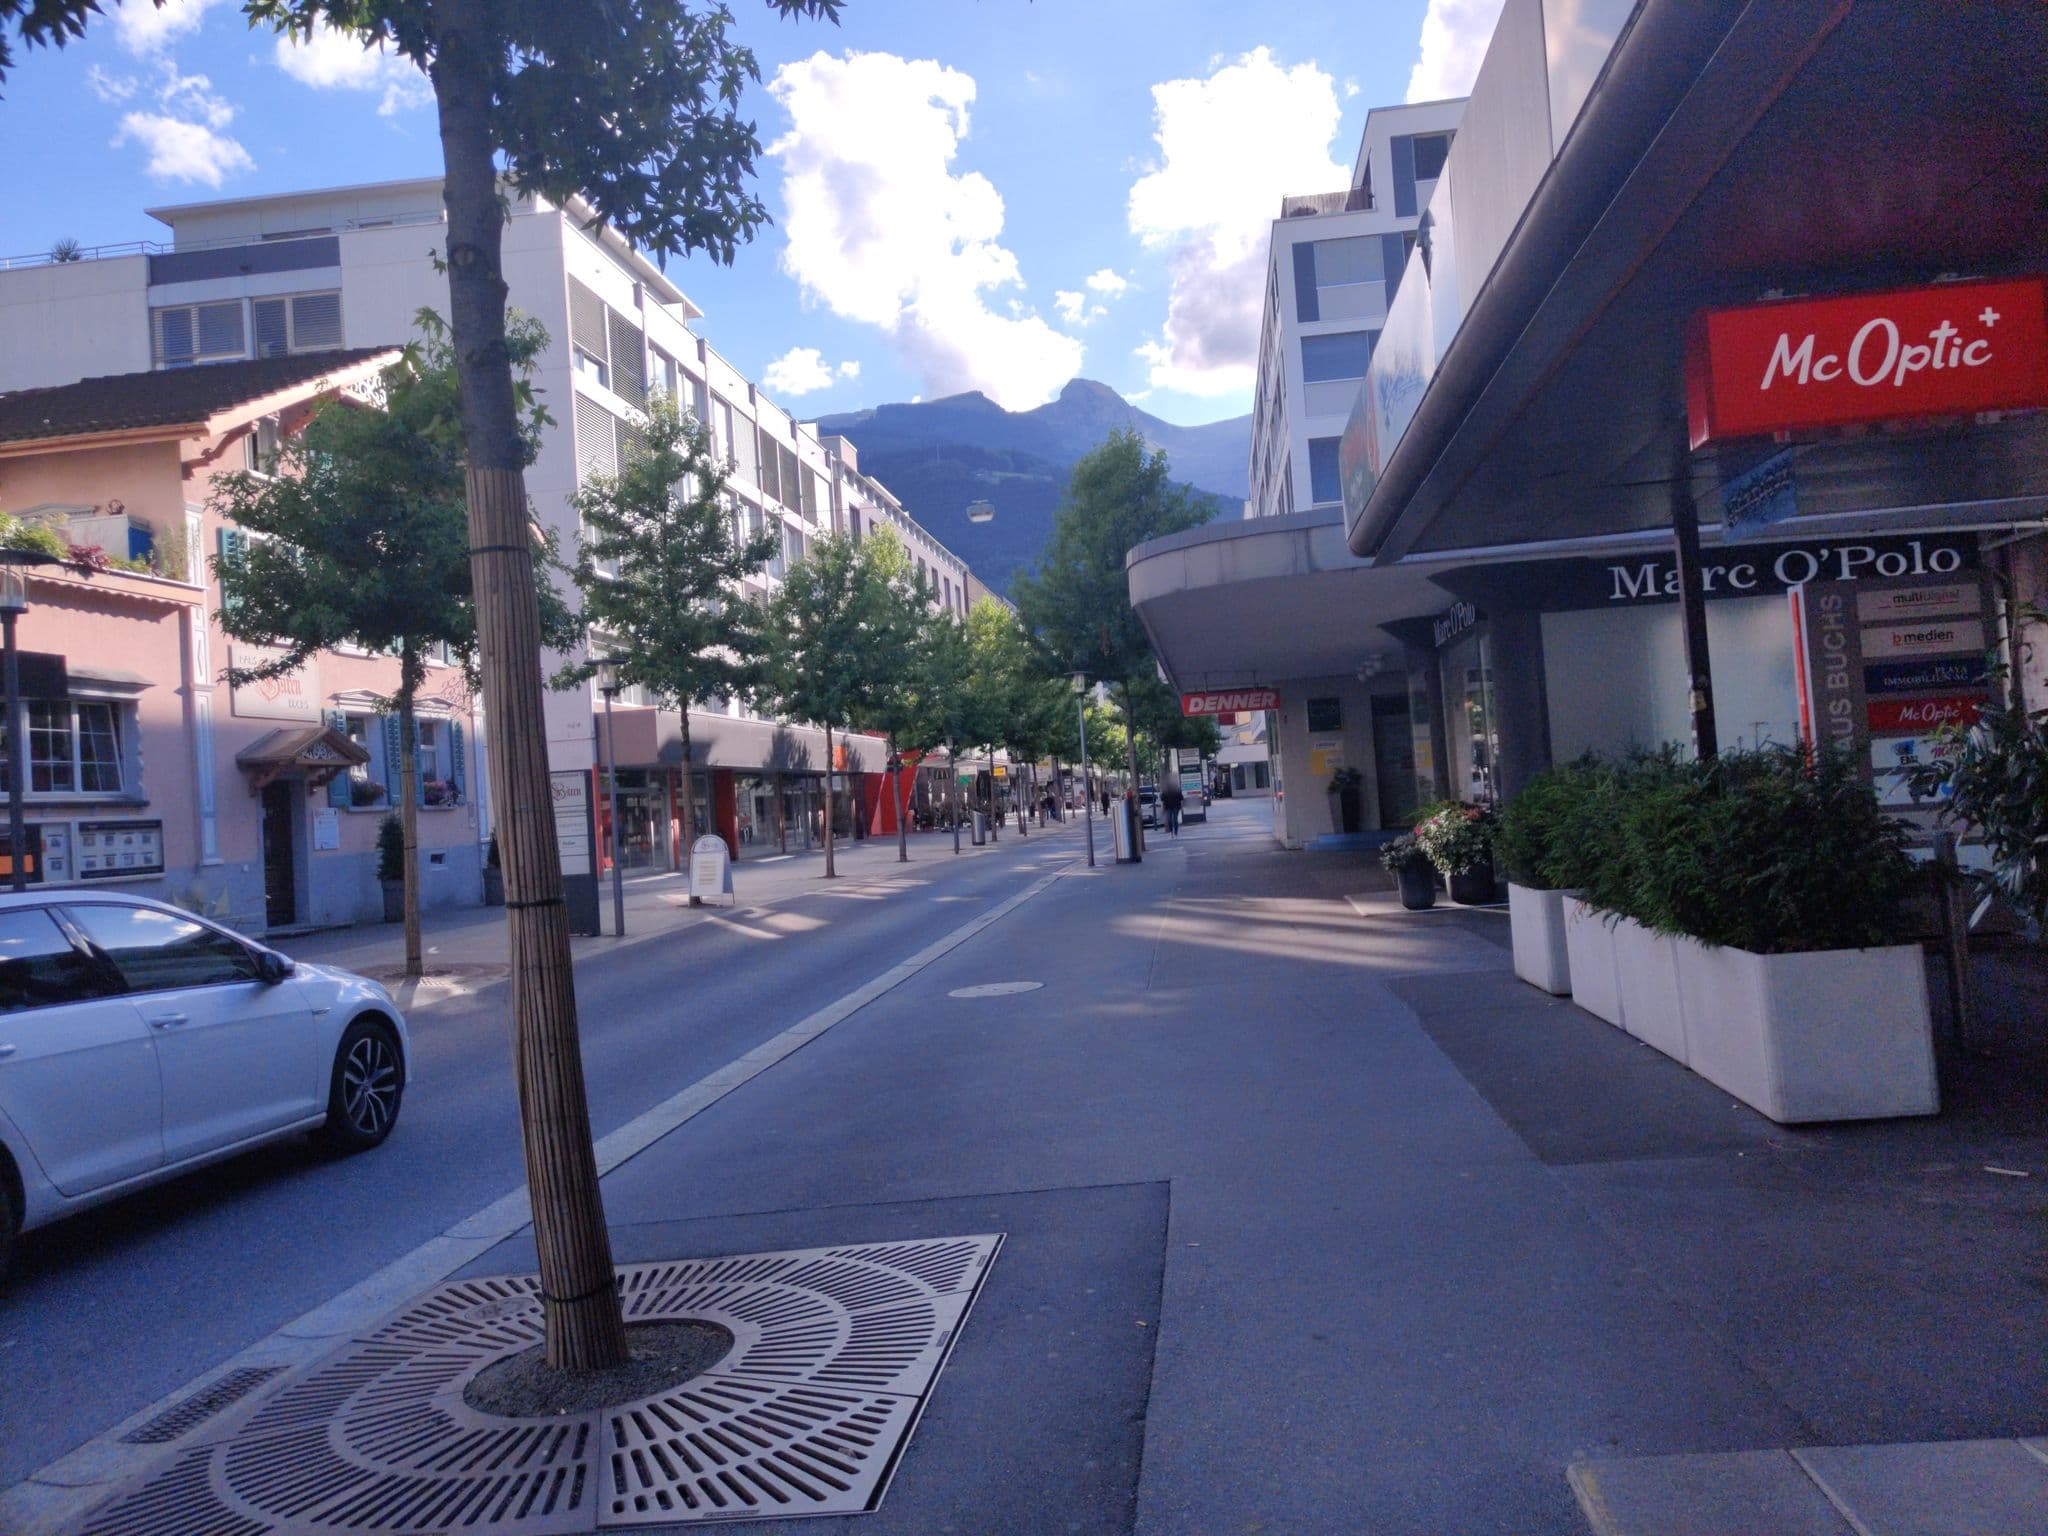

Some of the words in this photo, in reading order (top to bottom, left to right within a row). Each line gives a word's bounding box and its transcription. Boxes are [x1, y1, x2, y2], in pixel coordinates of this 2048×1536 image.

[1774, 541, 1962, 584] O'Polo
[1820, 594, 1849, 689] BUCHS
[1188, 691, 1278, 713] DENNER
